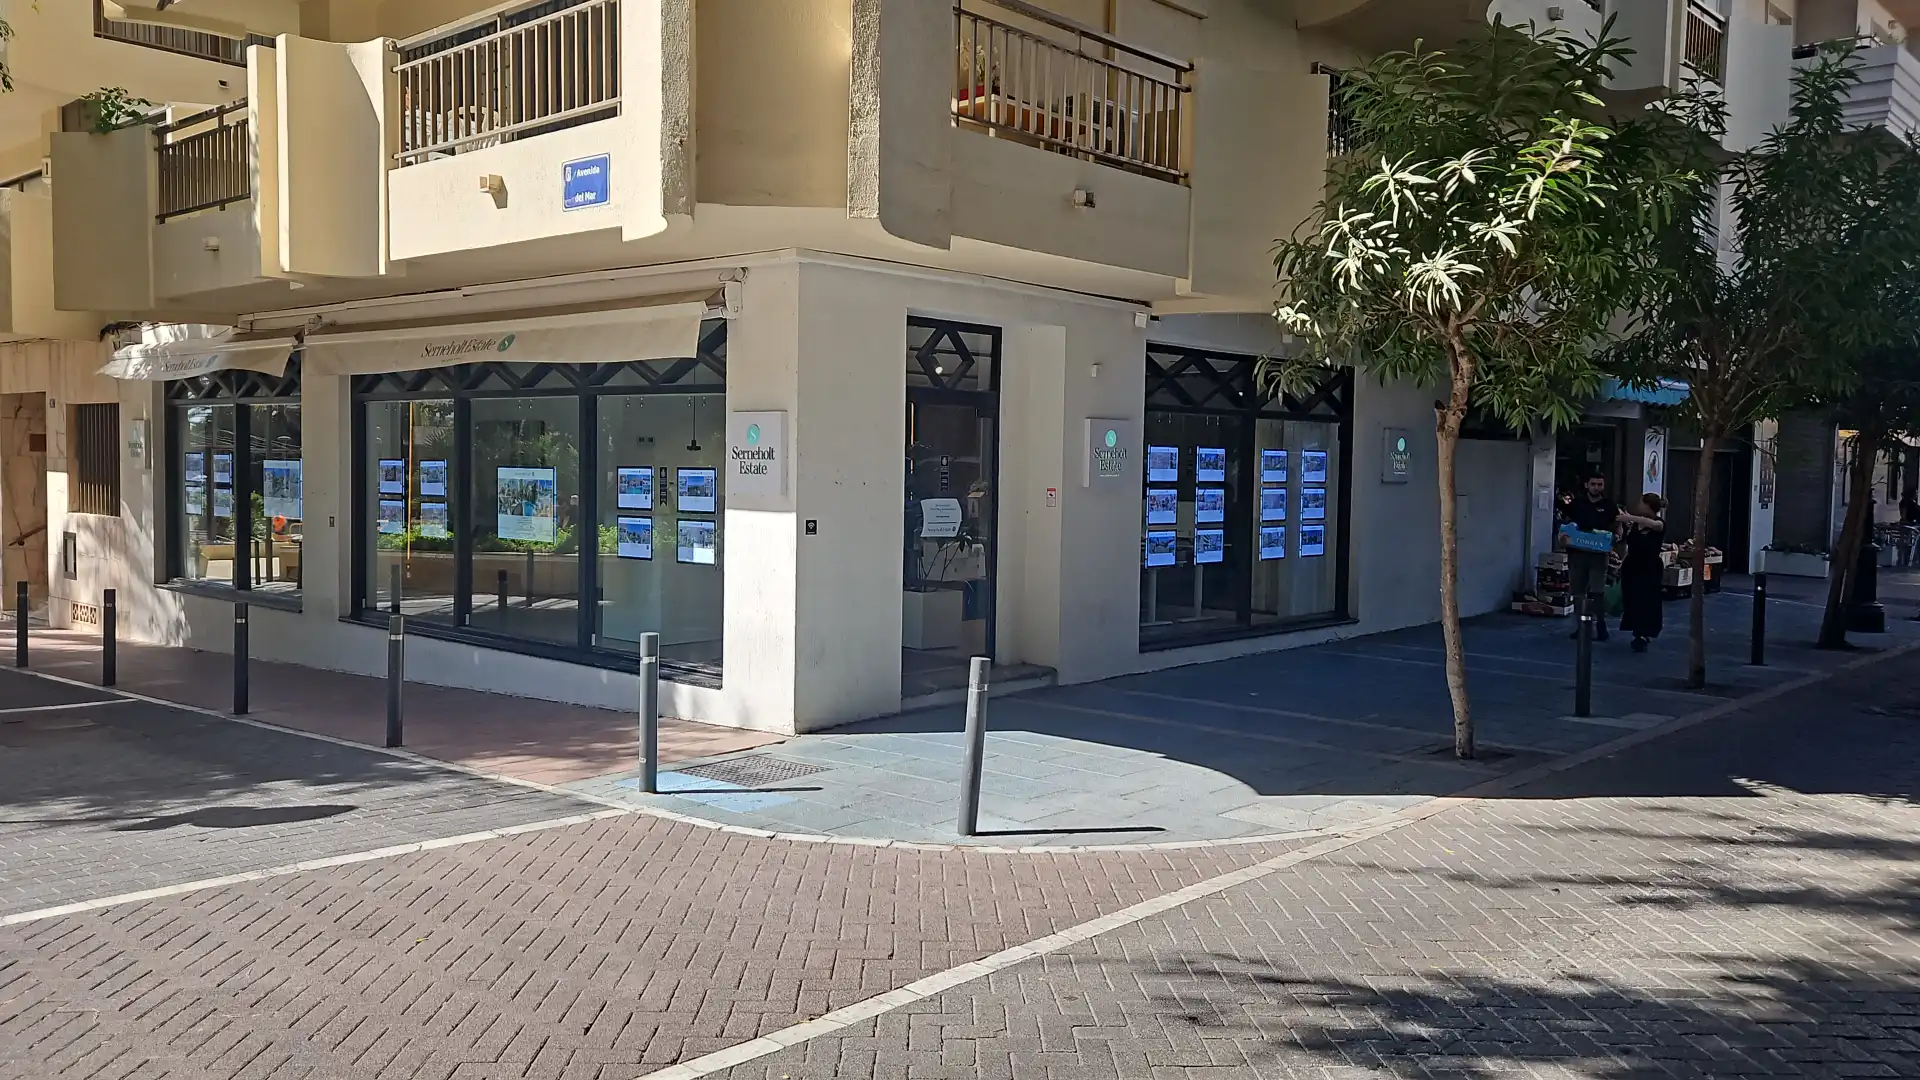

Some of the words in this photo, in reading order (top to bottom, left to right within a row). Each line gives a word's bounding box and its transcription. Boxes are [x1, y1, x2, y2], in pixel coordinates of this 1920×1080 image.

[576, 165, 600, 178] Avenida
[574, 193, 584, 203] del
[584, 191, 597, 201] Mar
[421, 339, 467, 358] Serneholt
[464, 338, 496, 354] Estate
[731, 445, 776, 461] Serneholt
[739, 460, 768, 475] Estate
[1100, 459, 1122, 471] Estate
